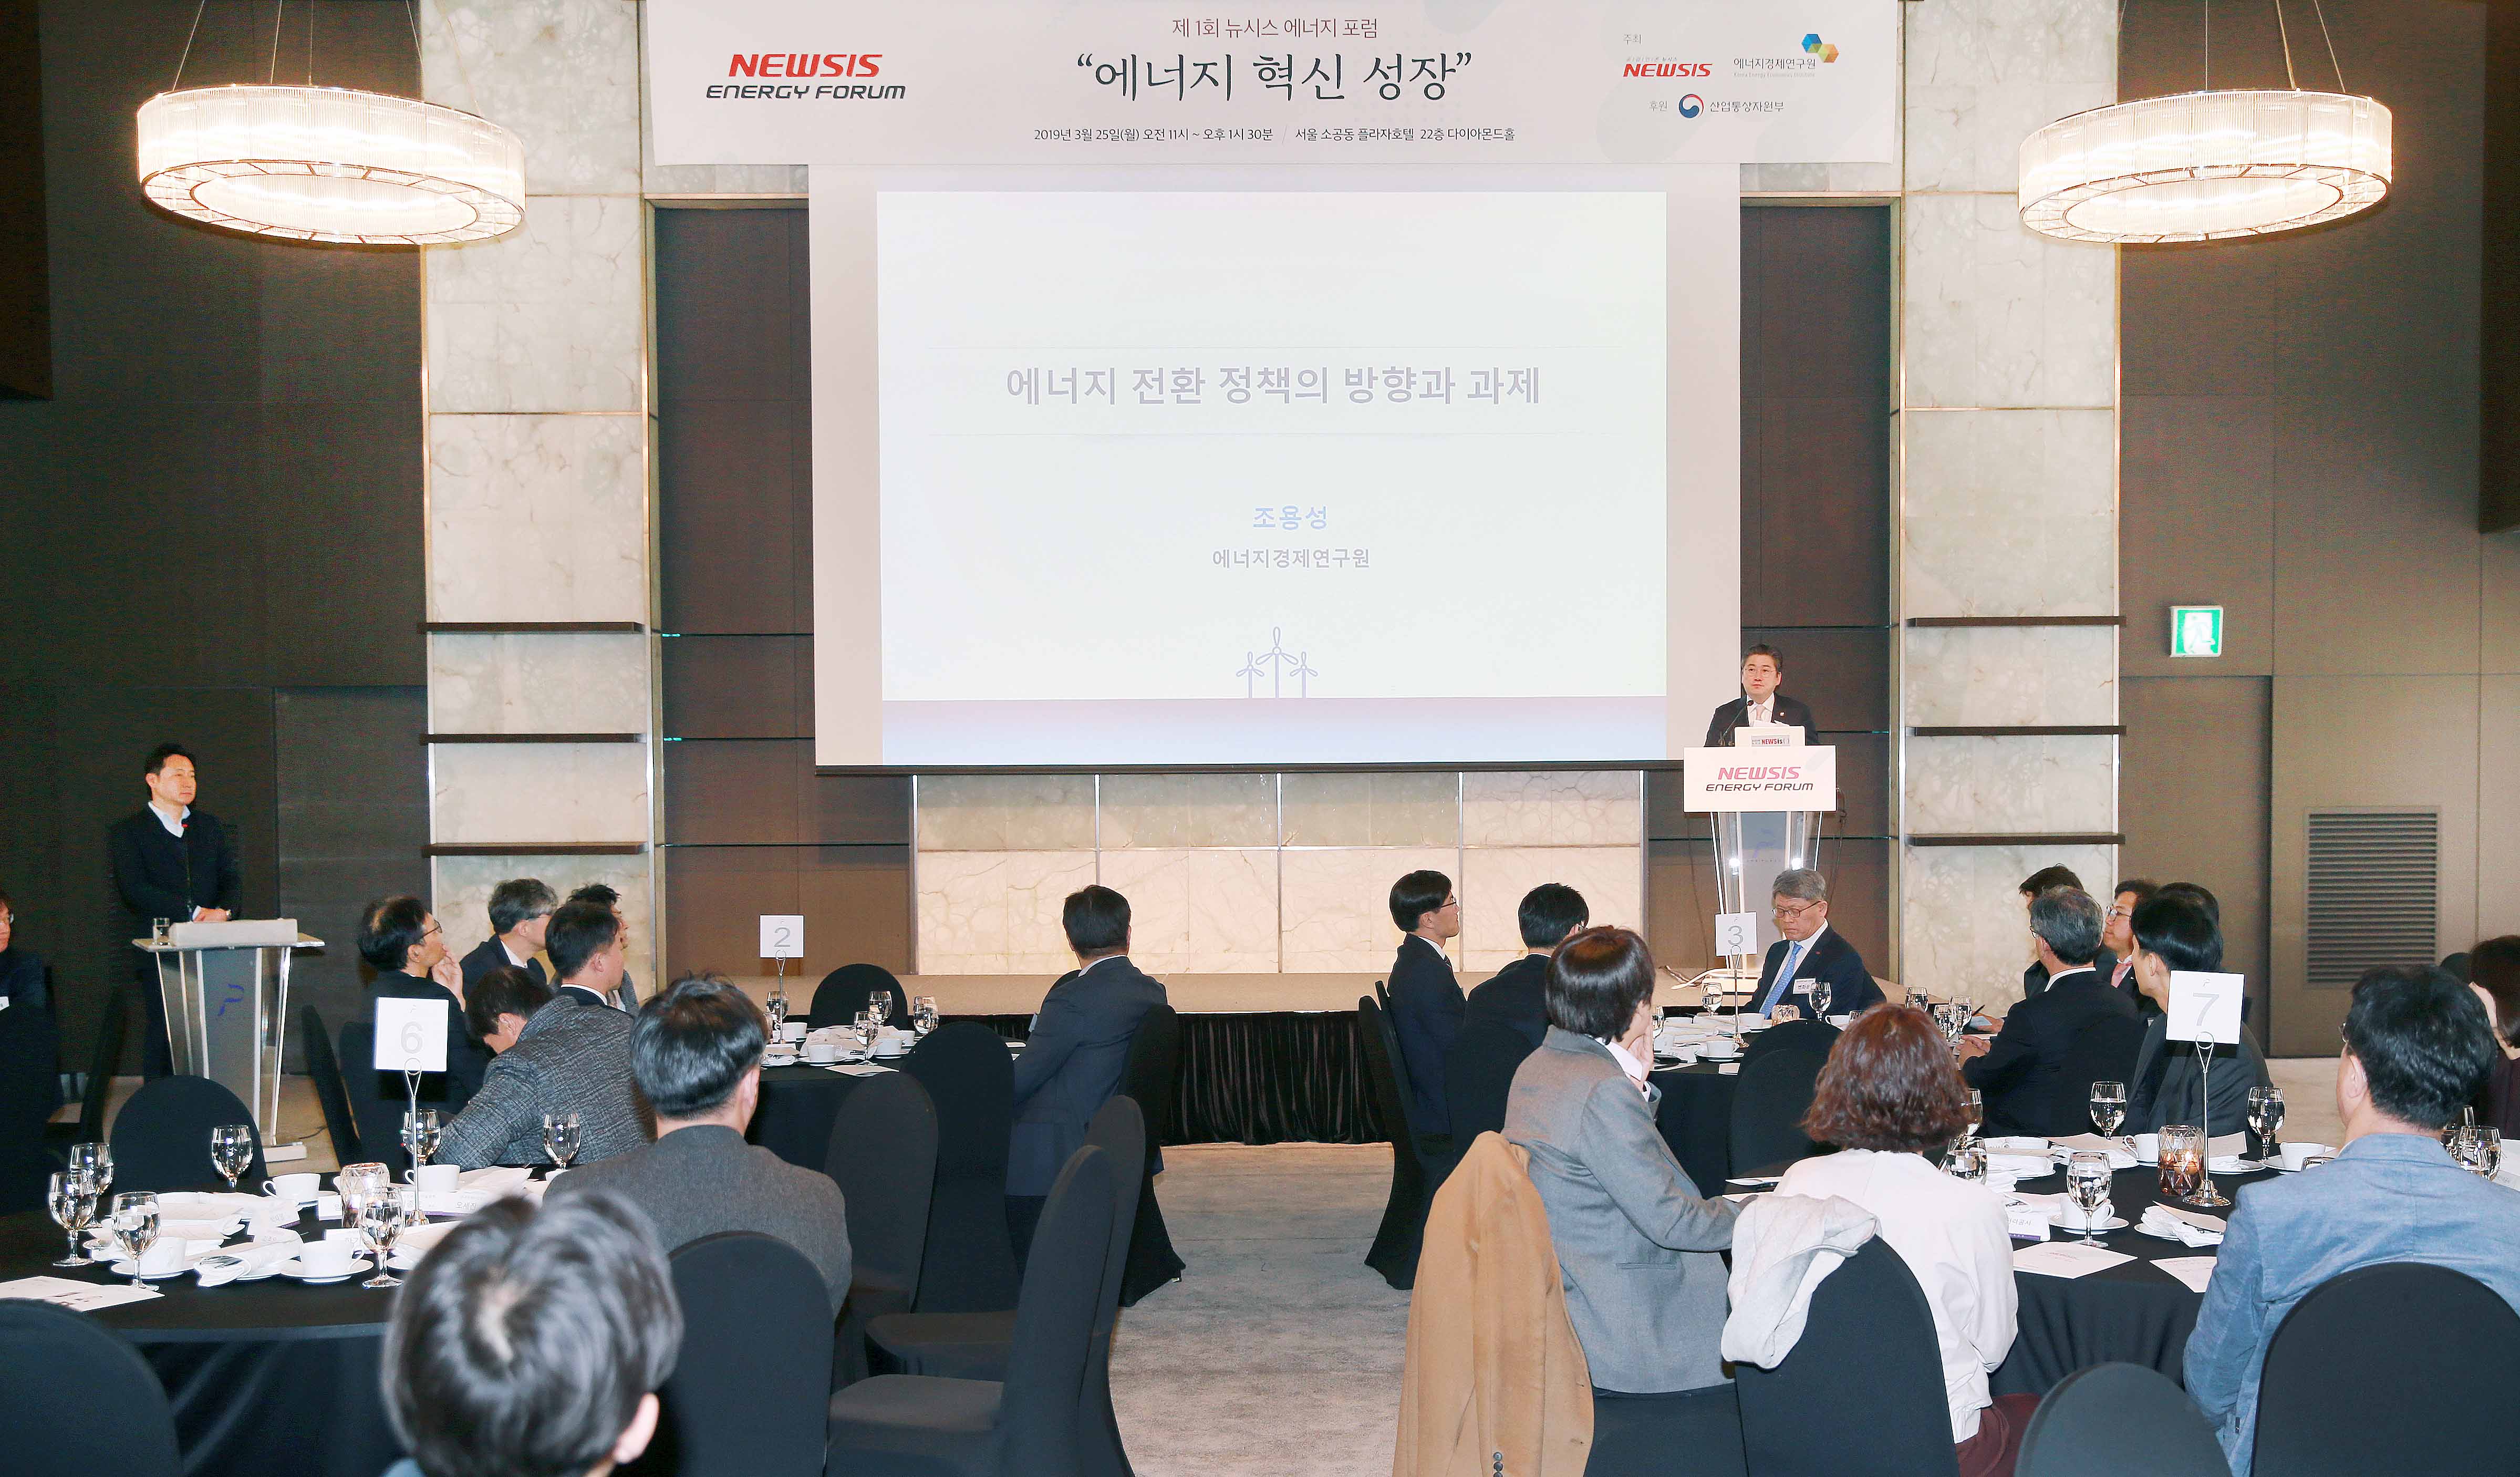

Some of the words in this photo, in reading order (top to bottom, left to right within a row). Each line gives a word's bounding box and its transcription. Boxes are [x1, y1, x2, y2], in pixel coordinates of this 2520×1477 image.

[1173, 18, 1189, 38] 제
[1195, 18, 1219, 38] 1회
[1225, 18, 1279, 38] 뉴시스
[1284, 18, 1336, 38] 에너지
[1342, 18, 1377, 38] 포럼
[1623, 34, 1642, 45] 주최
[729, 54, 883, 77] NEWSIS
[1623, 64, 1713, 77] NEWSIS
[1734, 58, 1816, 70] 에너지경제연구원
[1077, 54, 1232, 101] “에너지
[1252, 54, 1345, 101] 혁신
[1362, 52, 1471, 101] 성장”
[706, 86, 810, 99] ENERGY
[815, 86, 906, 99] FORUM
[1649, 101, 1668, 111] 후원
[1710, 101, 1784, 112] 산업통상자원부
[1034, 129, 1071, 141] 2019년
[1075, 128, 1092, 141] 3월
[1096, 128, 1139, 142] 25일(월)
[1143, 128, 1165, 141] 오전
[1169, 128, 1189, 141] 11시
[1202, 128, 1226, 141] 오후
[1229, 128, 1244, 140] 1시
[1248, 128, 1273, 141] 30분
[1295, 128, 1318, 141] 서울
[1320, 128, 1354, 141] 소공동
[1357, 128, 1414, 141] 플라자호텔
[1420, 128, 1444, 141] 22층
[1447, 128, 1515, 141] 다이아몬드홀
[1007, 366, 1116, 405] 에너지
[1132, 366, 1206, 406] 전환
[1219, 366, 1329, 405] 정책의
[1344, 366, 1456, 405] 방향과
[1467, 366, 1540, 405] 과제
[1253, 504, 1328, 531] 조용성
[1212, 548, 1370, 569] 에너지경제연구원
[1718, 767, 1801, 780] NEWSIS
[1765, 783, 1813, 791] FORUM
[773, 926, 791, 948] 2
[1727, 925, 1744, 946] 3
[2193, 992, 2220, 1026] 7
[400, 1021, 424, 1055] 6
